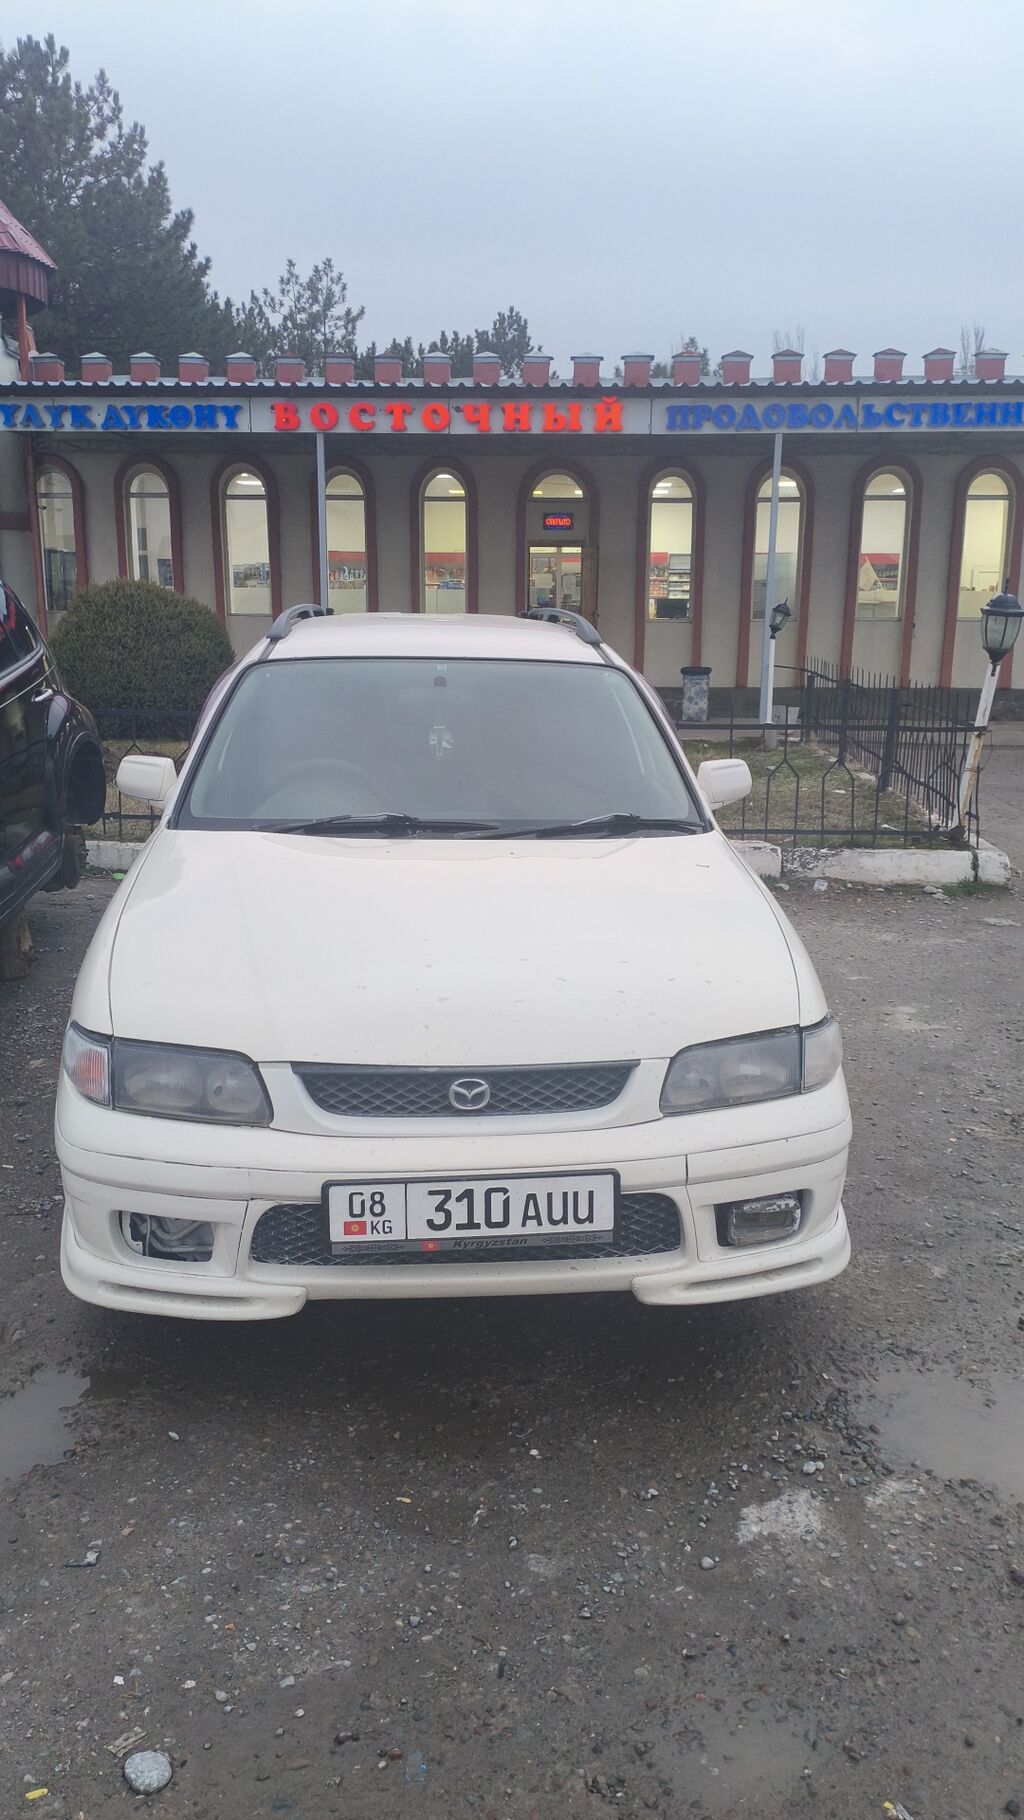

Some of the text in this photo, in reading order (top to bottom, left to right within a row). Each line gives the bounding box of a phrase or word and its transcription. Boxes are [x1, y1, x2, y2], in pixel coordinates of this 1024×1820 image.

[274, 396, 623, 431] ВОСТОЧНЫЙ
[666, 402, 1024, 431] ПРОДОВОЛЬСТВЕНН
[348, 1191, 386, 1218] 08
[426, 1187, 594, 1231] 310 AUU
[370, 1219, 393, 1235] KG
[452, 1236, 528, 1249] Kyrgyzstan
